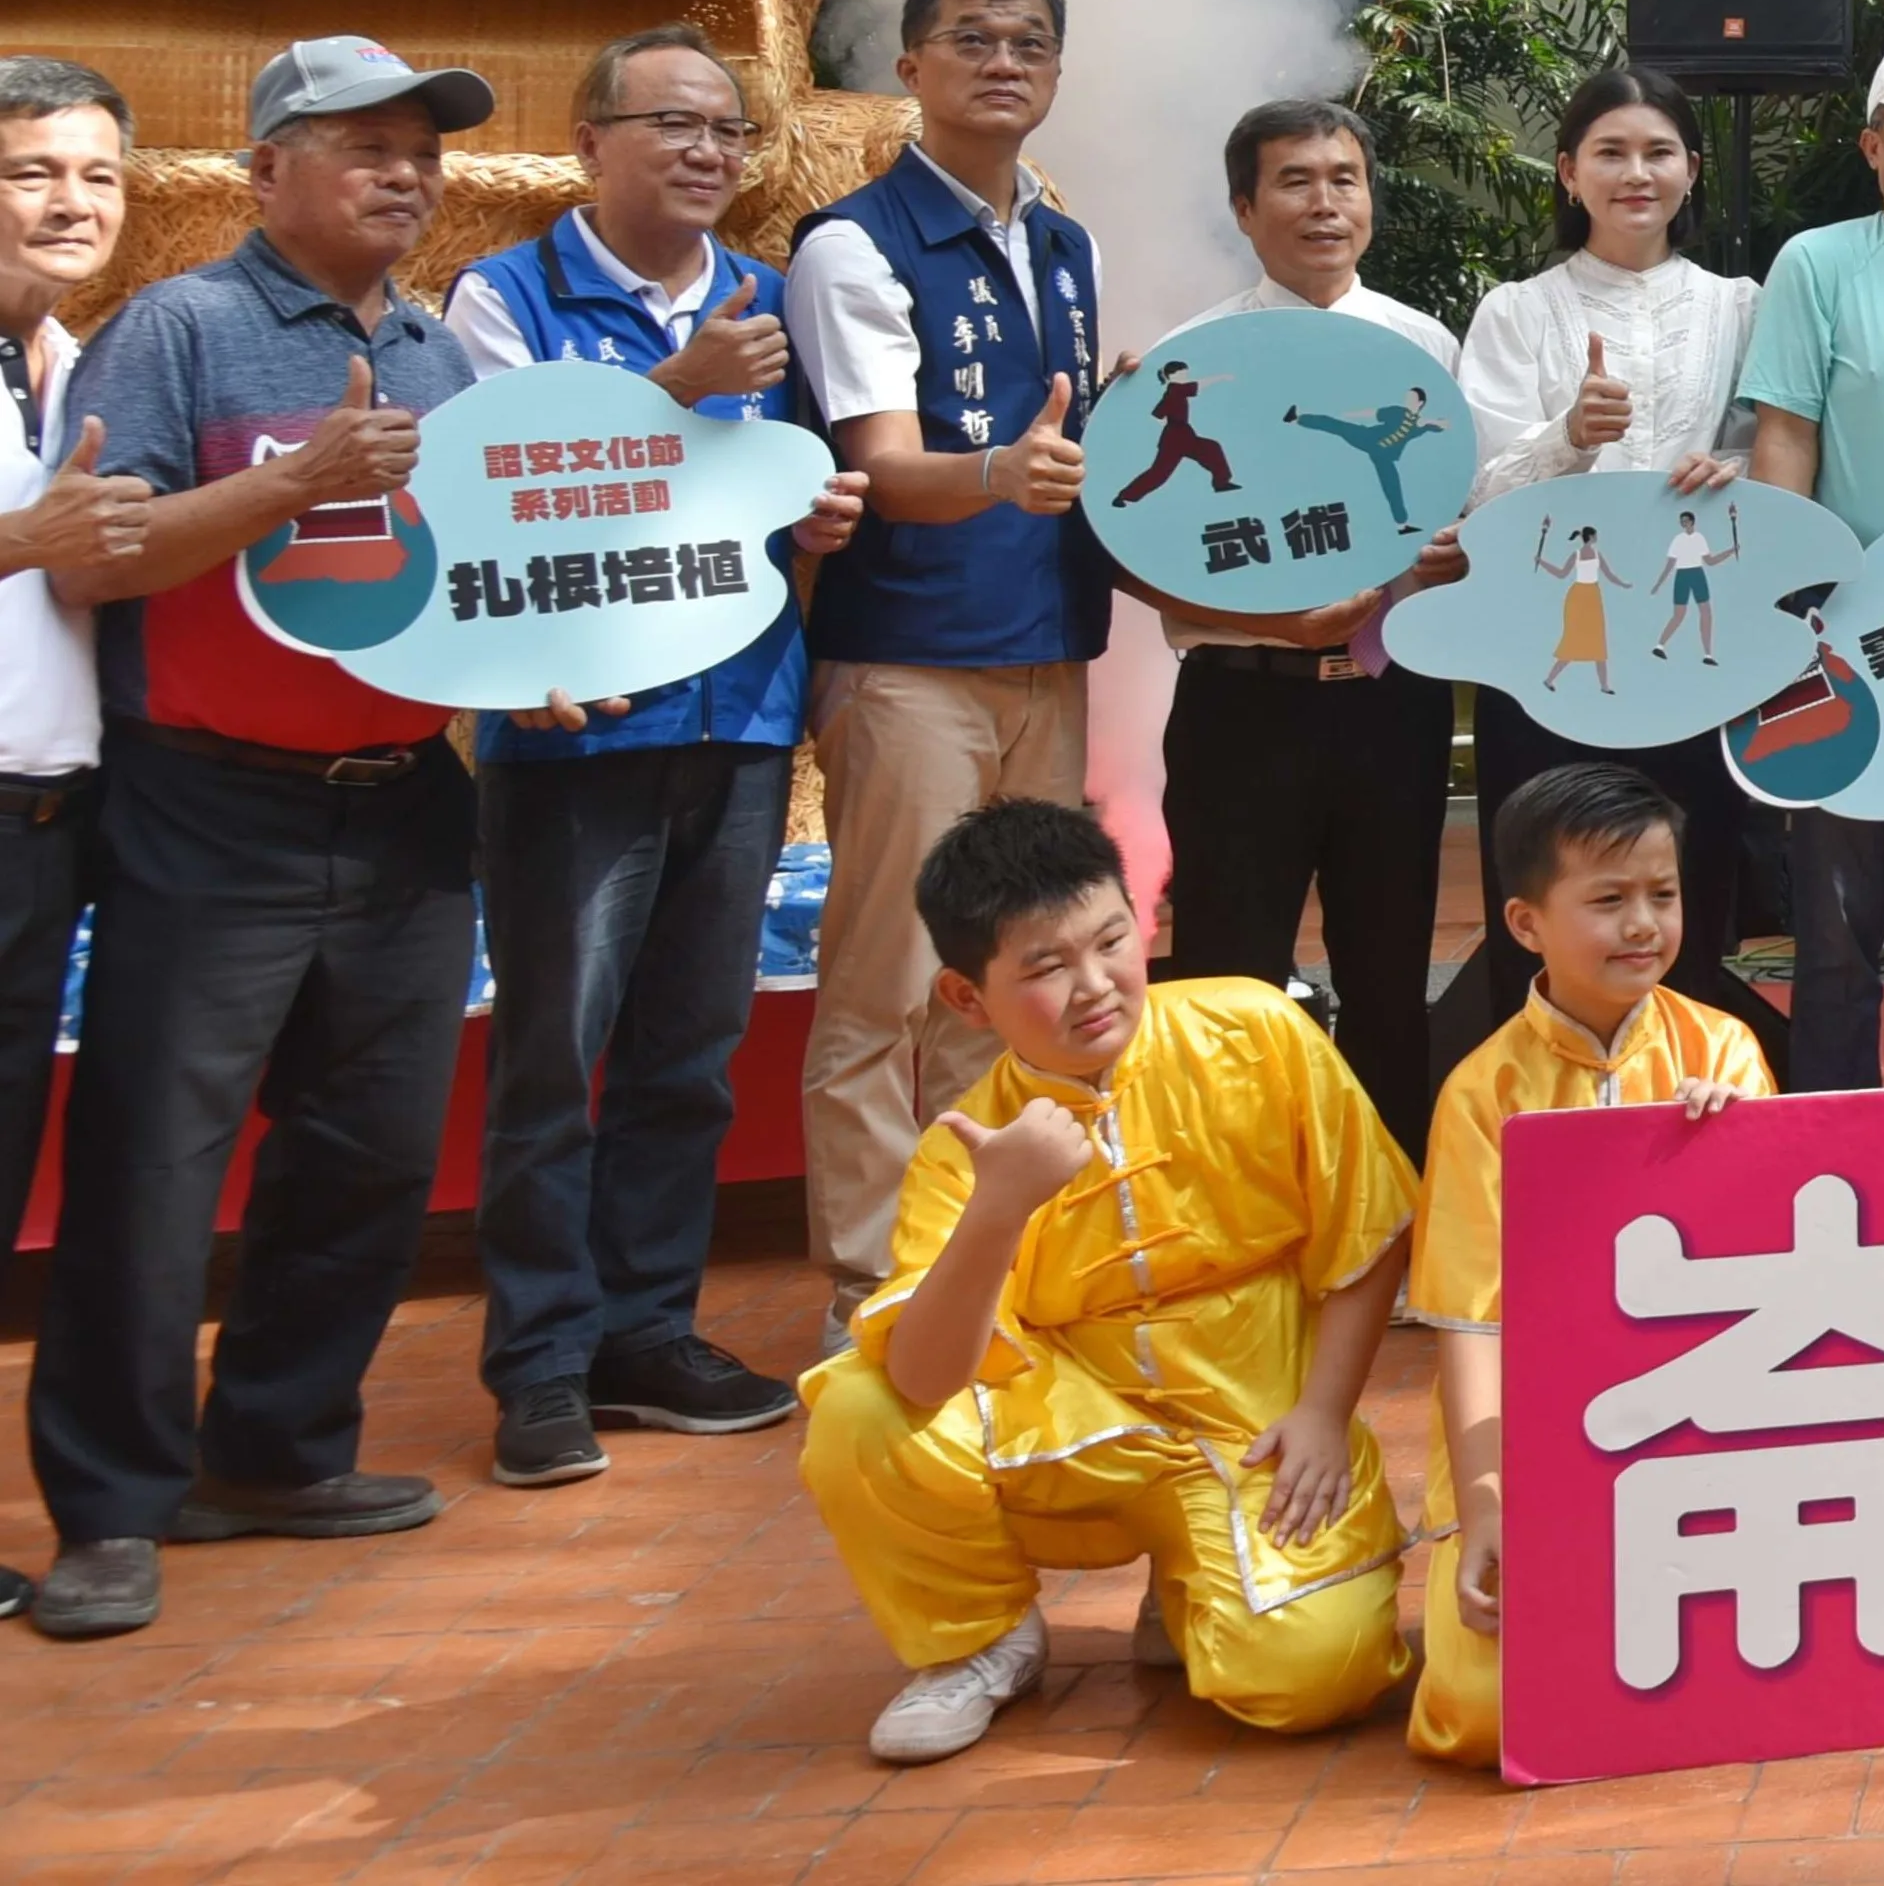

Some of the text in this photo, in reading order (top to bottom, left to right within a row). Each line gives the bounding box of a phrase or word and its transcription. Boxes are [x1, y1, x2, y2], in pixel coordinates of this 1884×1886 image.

[484, 434, 685, 480] 詔安文化節
[510, 480, 672, 524] 系列活動
[1201, 502, 1351, 574] 武術
[447, 540, 750, 622] 扎根培植
